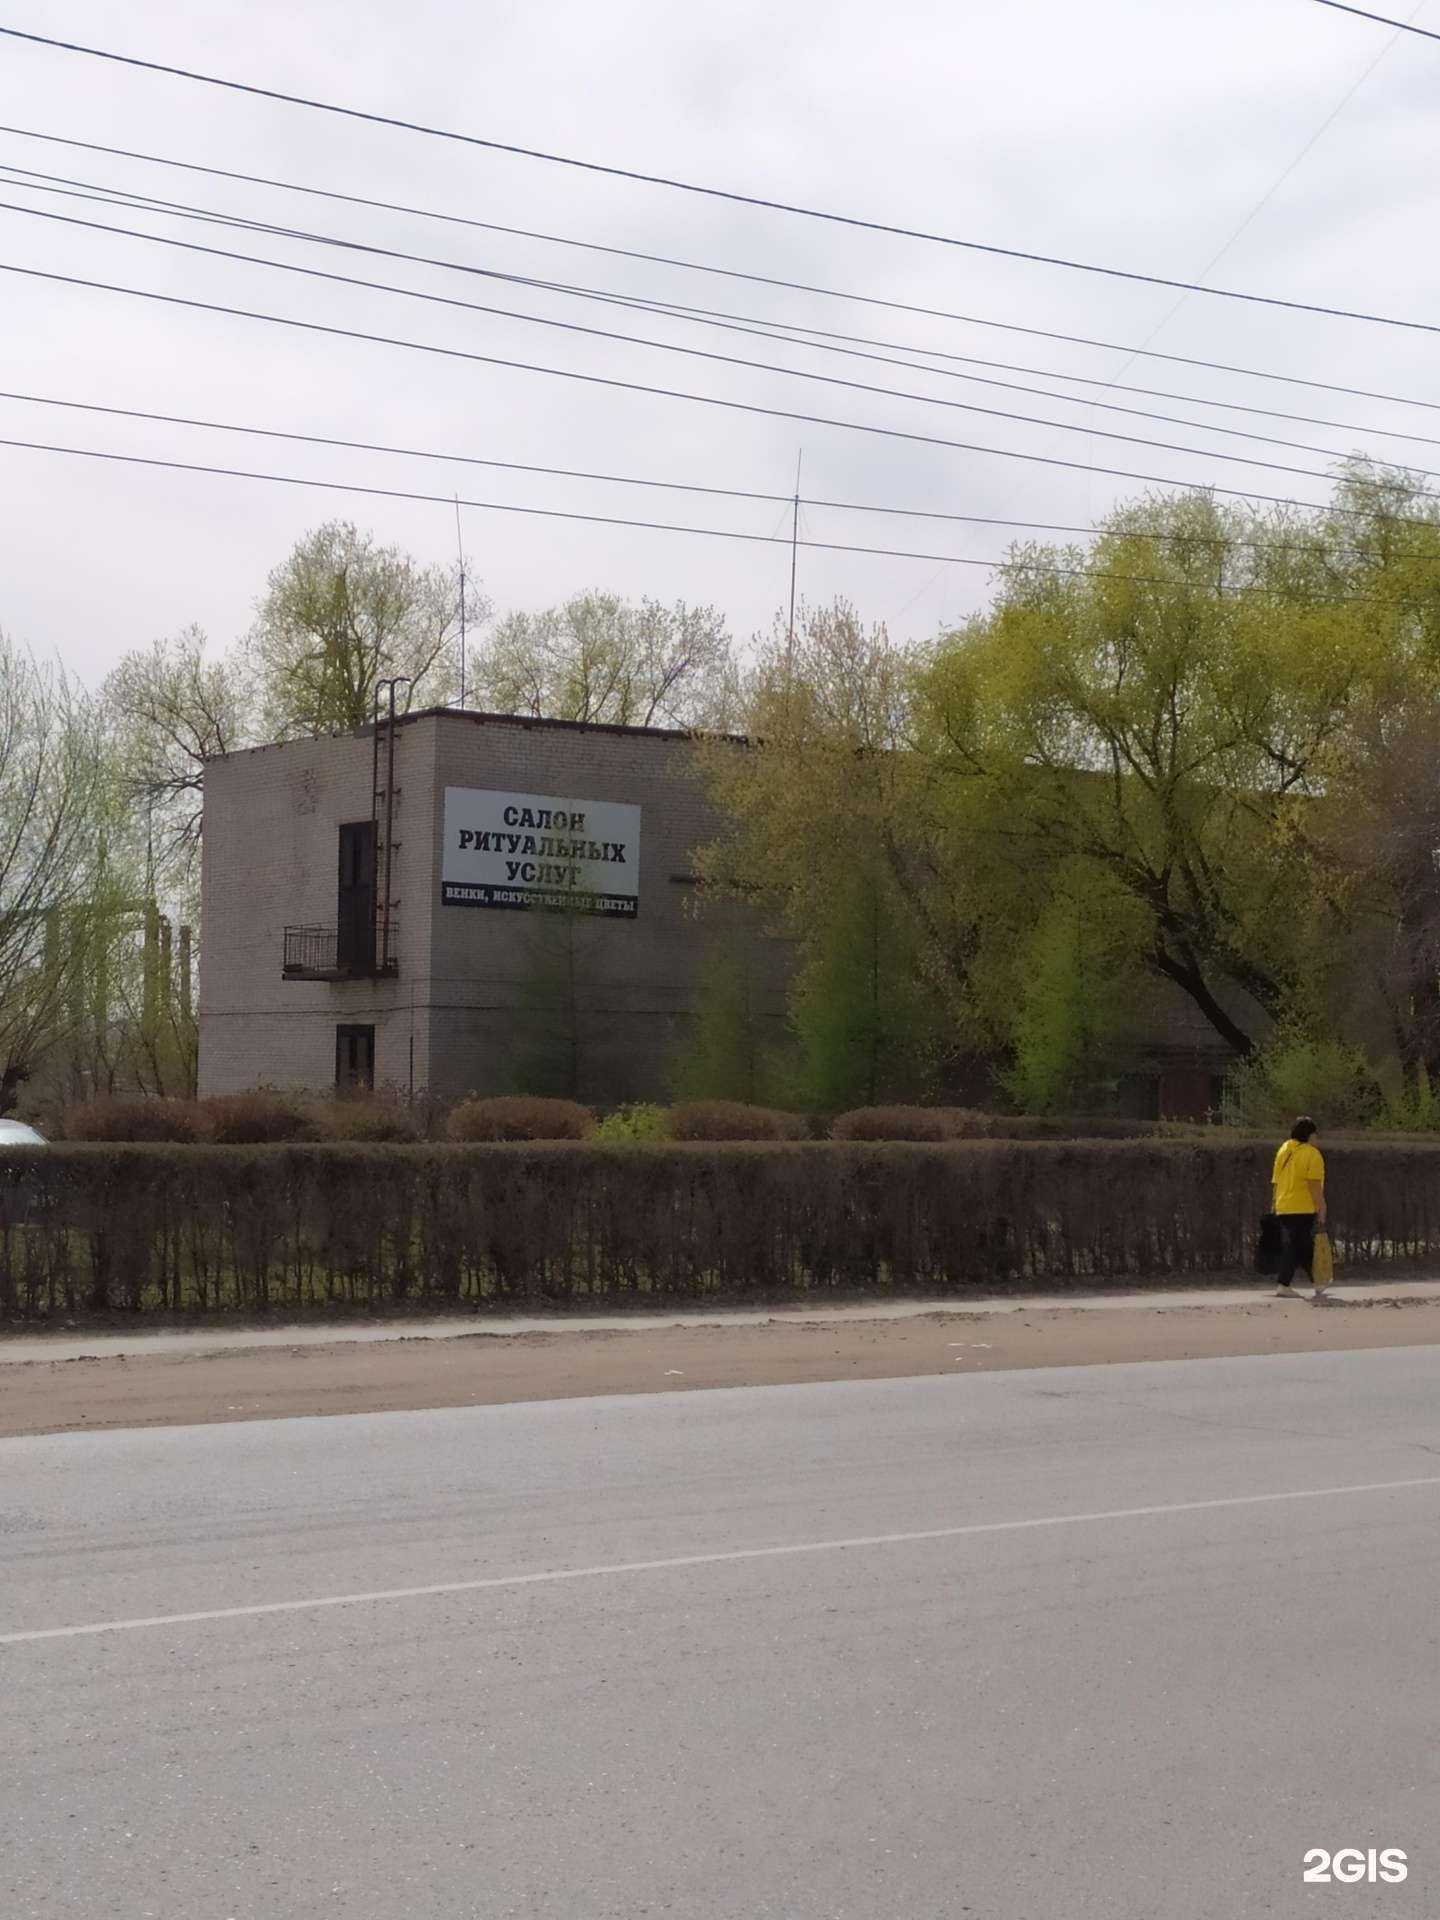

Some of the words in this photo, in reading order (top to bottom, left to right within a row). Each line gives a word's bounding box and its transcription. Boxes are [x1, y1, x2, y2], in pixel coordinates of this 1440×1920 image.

[503, 806, 585, 832] САЛОН
[459, 829, 626, 863] РИТУАЛЬНЫХ
[505, 861, 581, 885] УСЛУГ
[446, 887, 489, 902] ВЕНКИ,
[595, 897, 635, 912] ЦВЕТЫ
